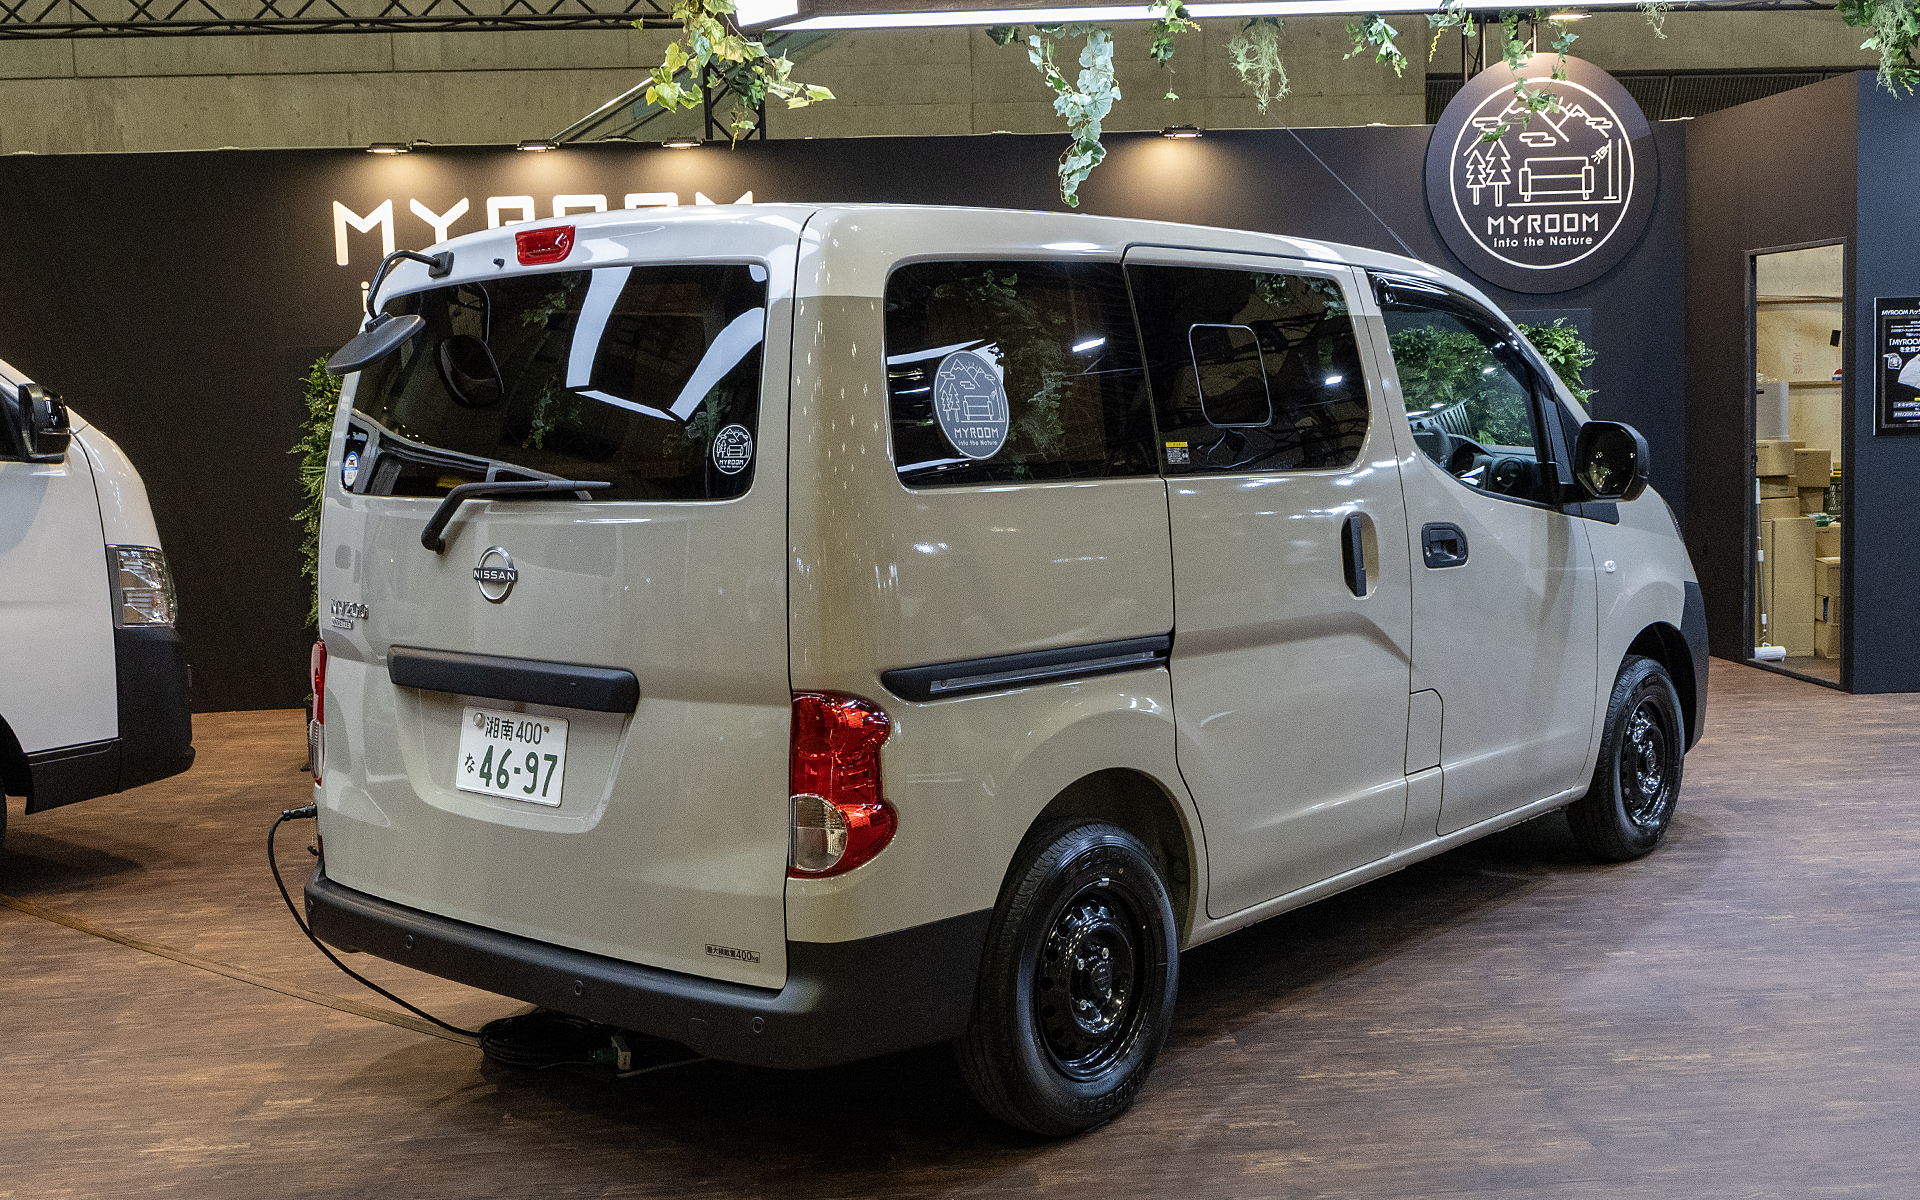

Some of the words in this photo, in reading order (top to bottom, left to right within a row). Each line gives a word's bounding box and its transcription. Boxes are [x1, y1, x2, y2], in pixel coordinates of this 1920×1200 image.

[1487, 212, 1599, 235] MYROOM
[1493, 237, 1519, 248] into
[1523, 236, 1545, 247] the
[1549, 235, 1593, 247] Nature
[954, 427, 999, 439] MYROOM
[473, 570, 515, 581] NISSAN
[464, 752, 475, 774] な
[479, 744, 558, 797] 46-97
